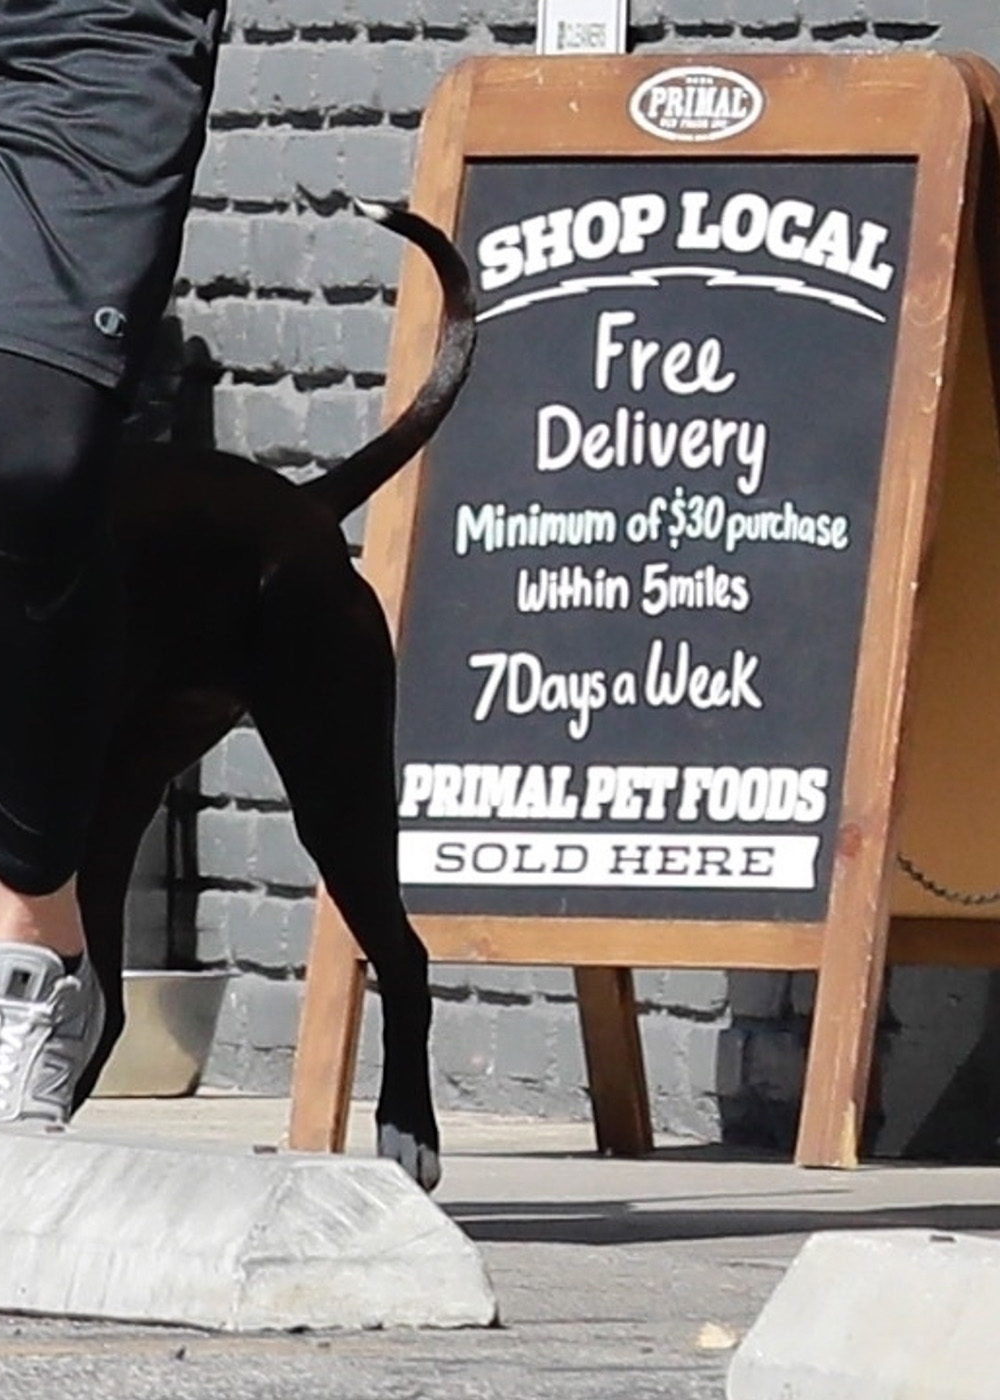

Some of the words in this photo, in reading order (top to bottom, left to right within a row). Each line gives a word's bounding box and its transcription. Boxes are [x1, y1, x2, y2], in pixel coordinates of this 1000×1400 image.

[647, 86, 749, 118] PRIMAL
[478, 194, 667, 291] SHOP
[676, 191, 894, 290] LOCAL
[594, 311, 736, 394] Free
[536, 404, 767, 494] Delivery
[454, 504, 616, 555] Minimum
[626, 497, 667, 542] of
[668, 486, 725, 549] $30
[726, 502, 850, 552] purchase
[517, 566, 630, 613] Within
[611, 671, 637, 706] a
[399, 764, 579, 818] PRIMAL
[580, 765, 678, 820] PET
[678, 766, 829, 822] FOODS
[434, 842, 588, 874] SOLD
[608, 845, 775, 877] HERE
